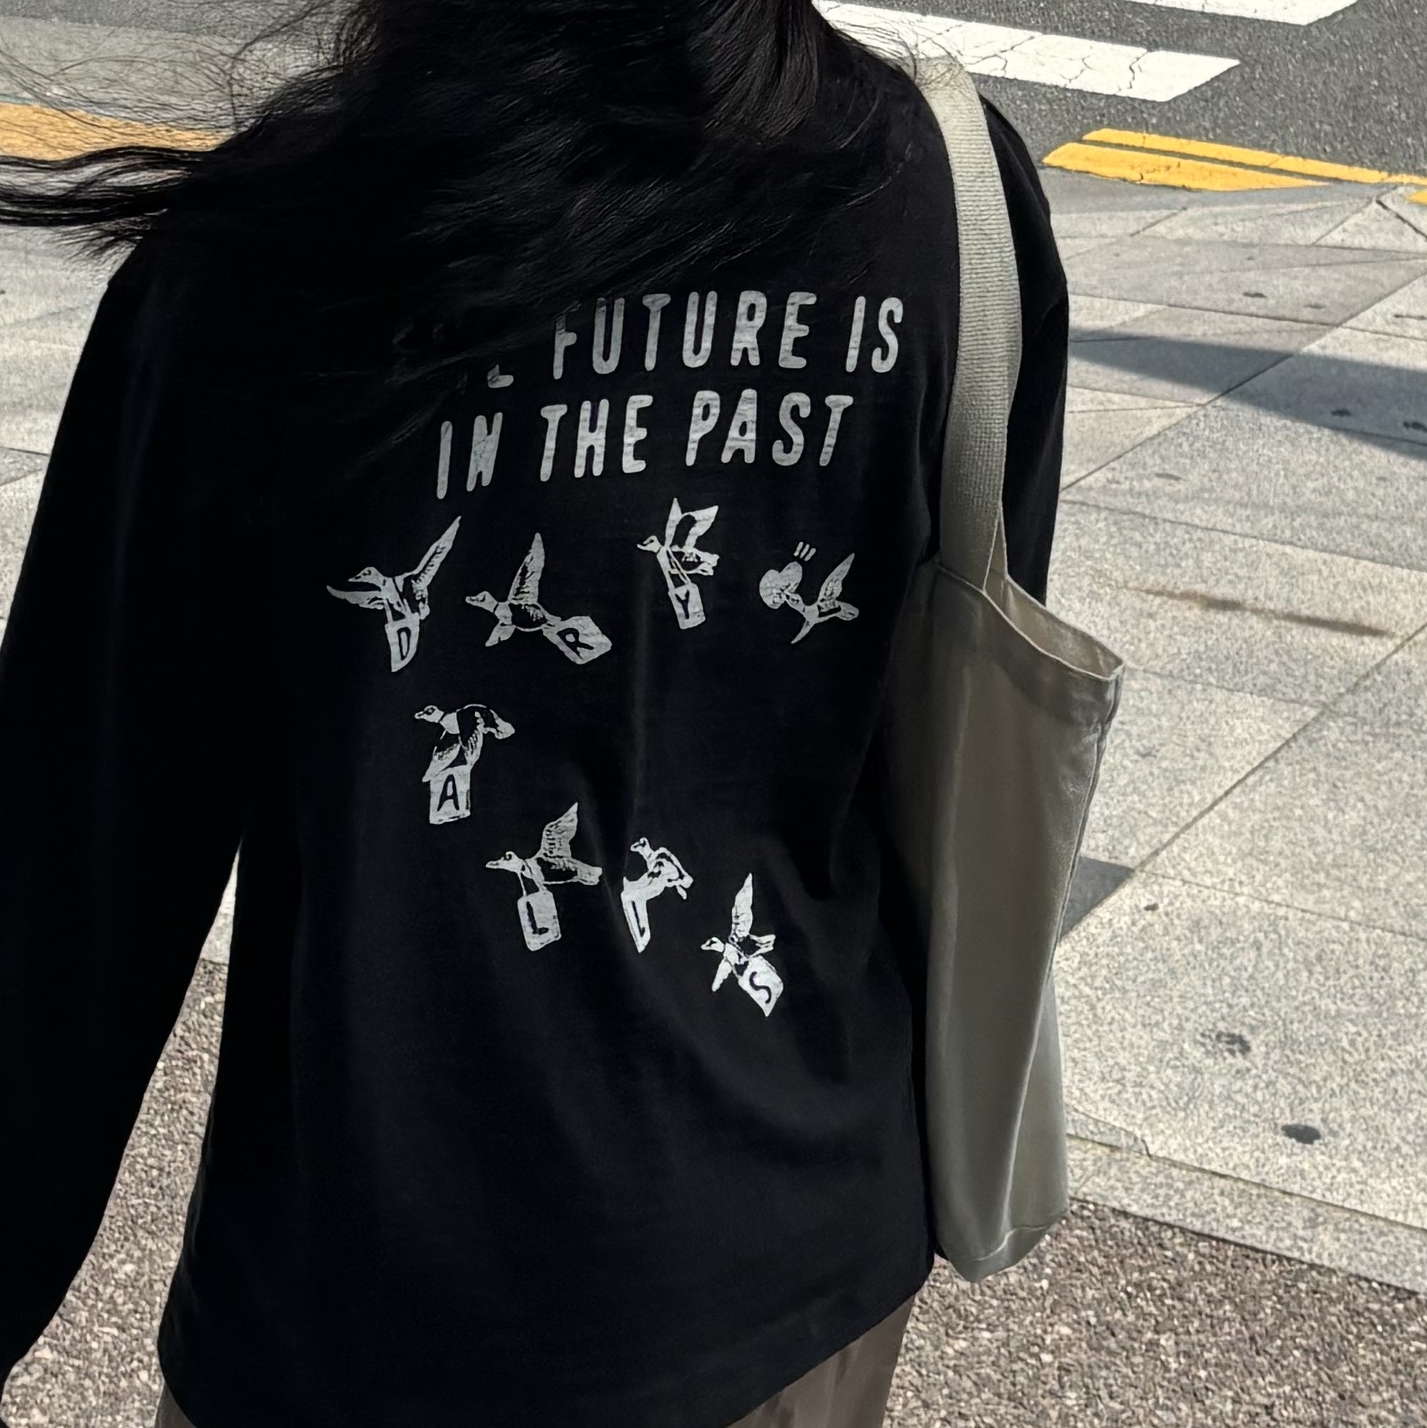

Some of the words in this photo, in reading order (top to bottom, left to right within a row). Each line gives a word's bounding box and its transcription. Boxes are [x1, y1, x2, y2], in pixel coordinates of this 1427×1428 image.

[552, 290, 817, 380] FUTURE
[845, 296, 904, 373] IS
[436, 412, 504, 500] IN
[540, 394, 654, 482] THE
[685, 388, 854, 467] PAST
[397, 626, 412, 661] D
[556, 628, 595, 660] R
[675, 589, 690, 619] Y
[436, 774, 460, 812] A
[526, 900, 549, 935] L
[748, 972, 772, 1004] S
